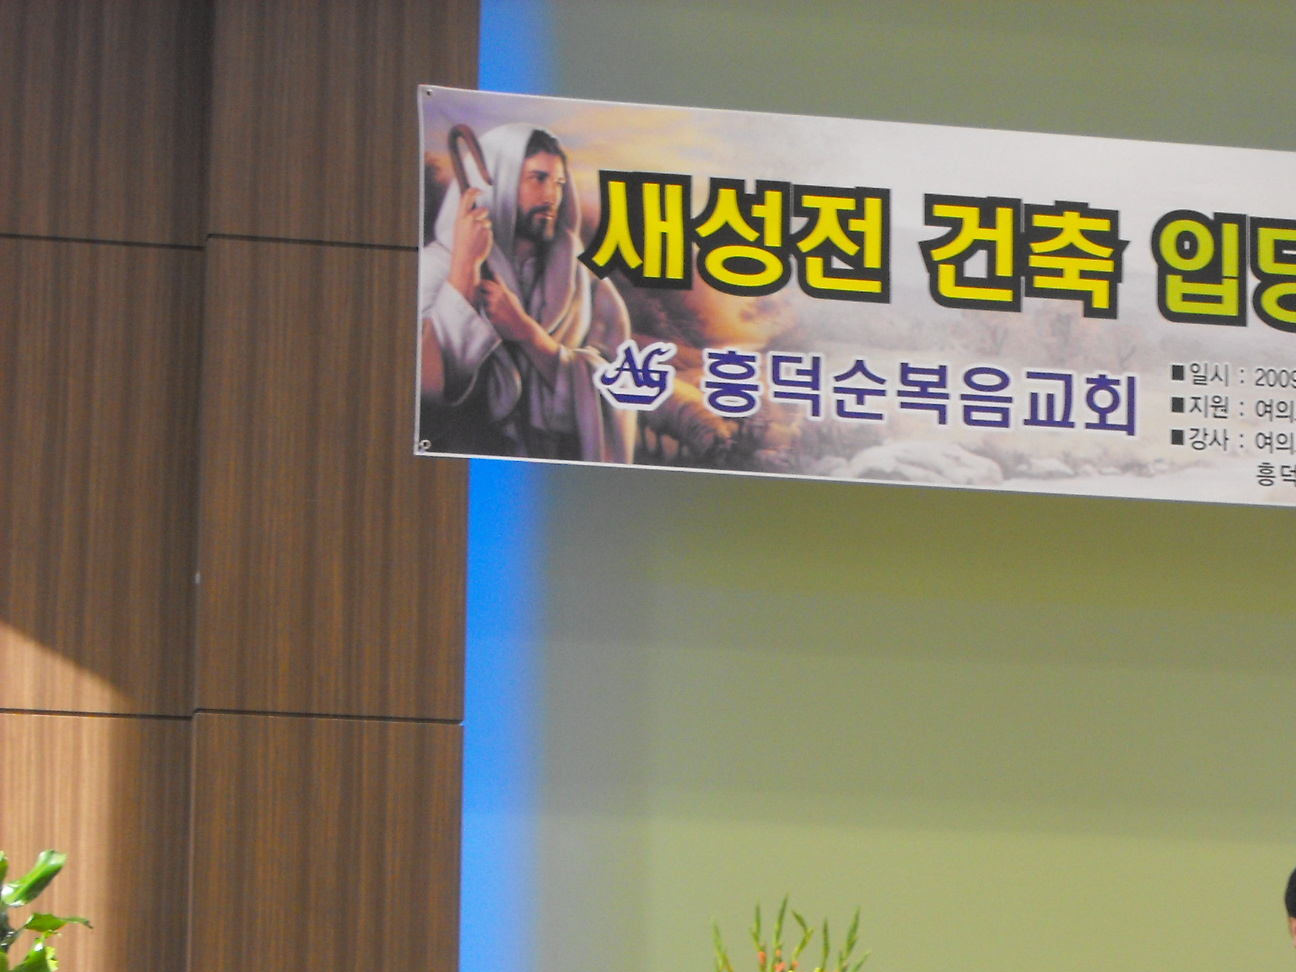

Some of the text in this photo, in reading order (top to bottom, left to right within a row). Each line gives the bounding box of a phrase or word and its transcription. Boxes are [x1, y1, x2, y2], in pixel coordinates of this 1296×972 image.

[589, 178, 886, 300] 새성전
[926, 198, 1123, 314] 건축
[1188, 363, 1230, 387] 일시
[705, 350, 1137, 435] 흥덕순복음교회
[1188, 396, 1229, 419] 지원
[1188, 428, 1229, 451] 강사
